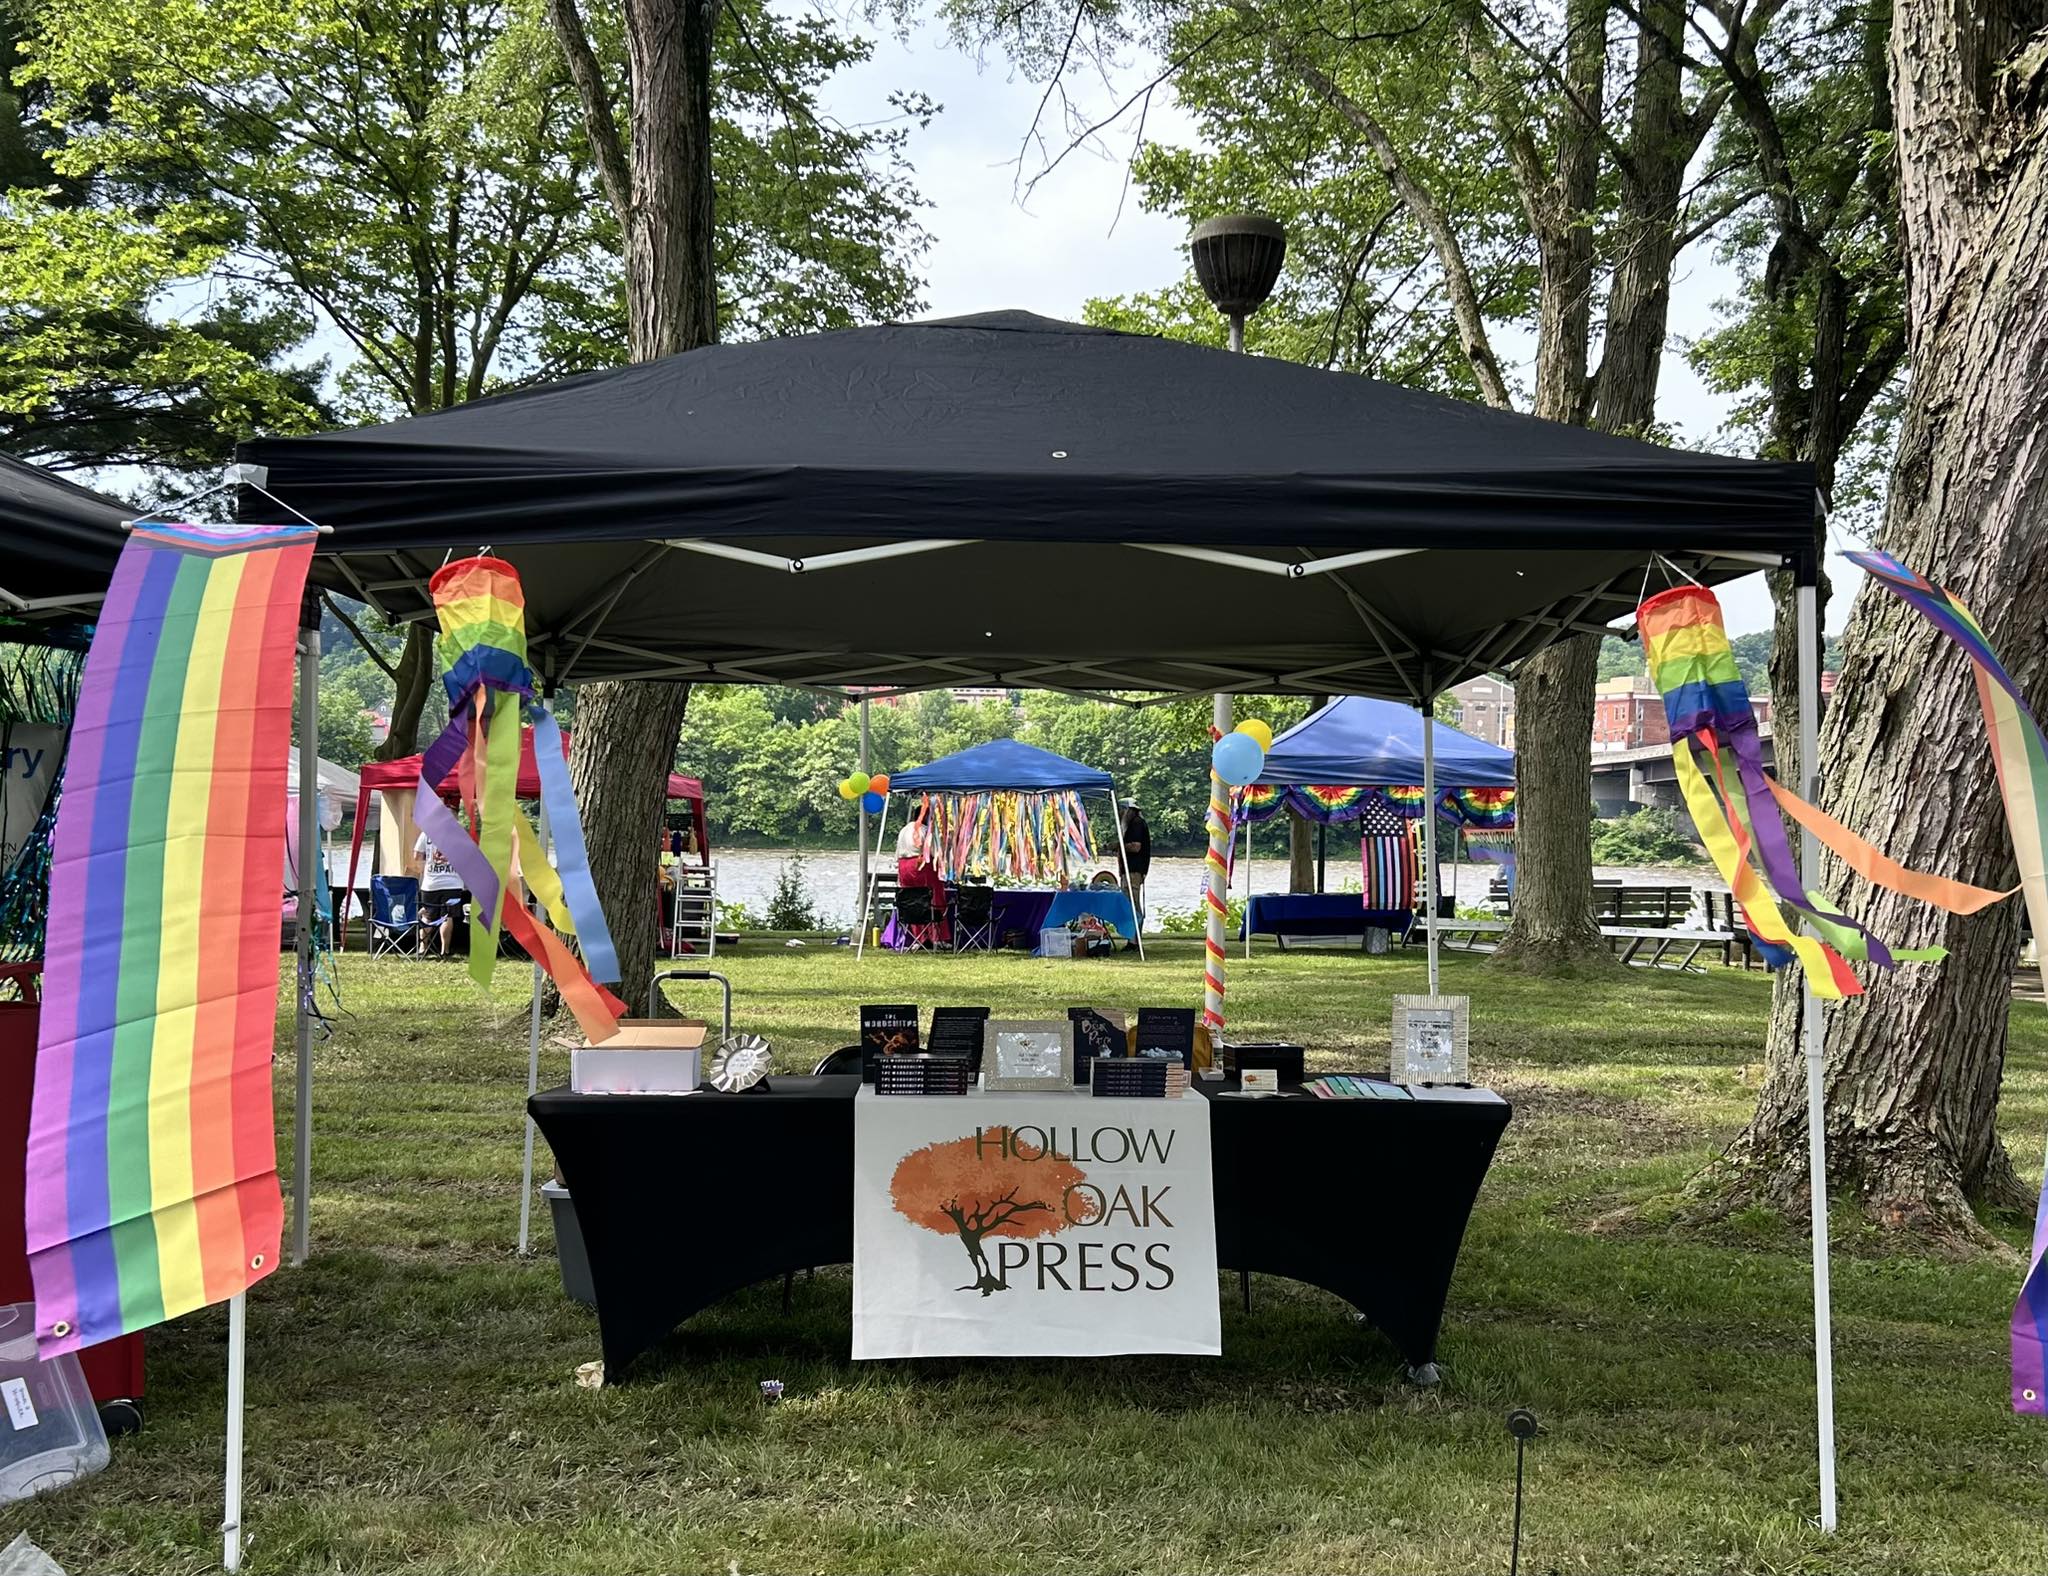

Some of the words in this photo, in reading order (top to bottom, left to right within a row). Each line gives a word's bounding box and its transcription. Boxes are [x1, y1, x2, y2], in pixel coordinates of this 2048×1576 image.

[0, 747, 45, 780] ry
[976, 1125, 1176, 1164] HOLLOW
[1063, 1183, 1175, 1228] OAK
[998, 1242, 1175, 1292] PRESS
